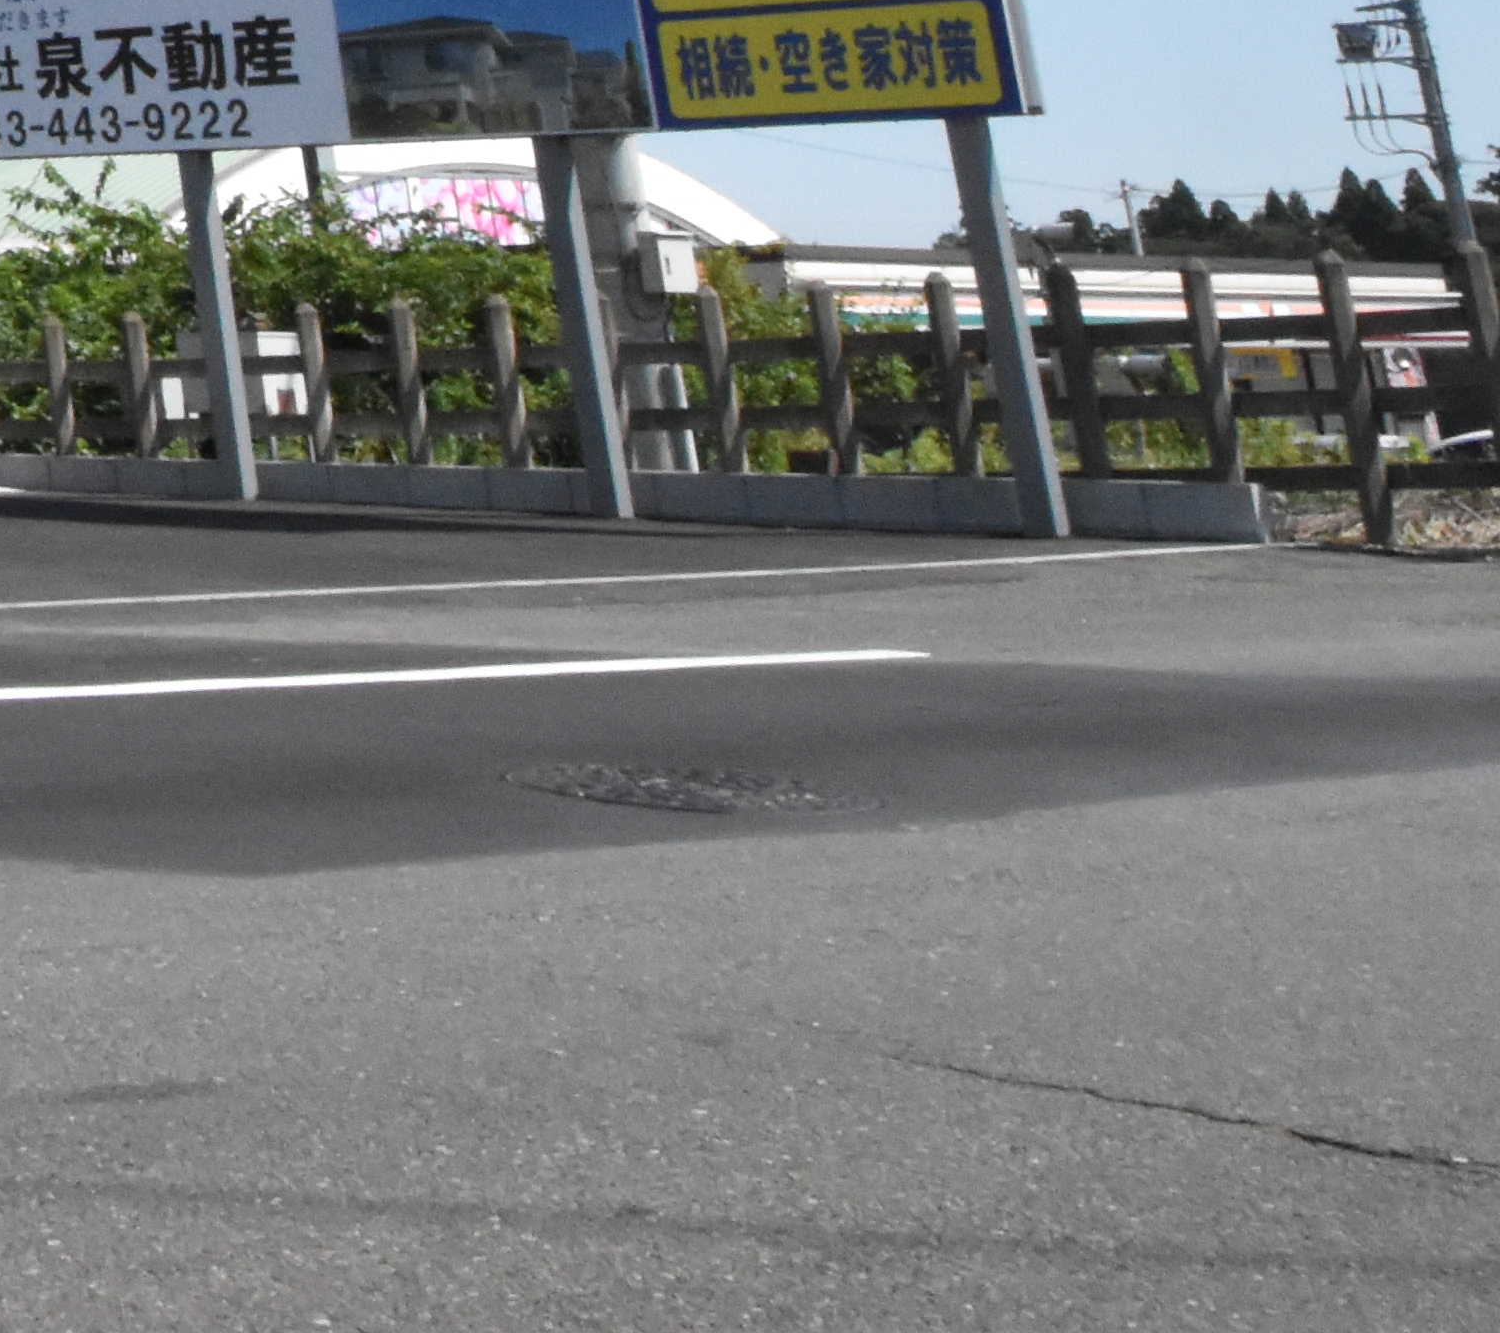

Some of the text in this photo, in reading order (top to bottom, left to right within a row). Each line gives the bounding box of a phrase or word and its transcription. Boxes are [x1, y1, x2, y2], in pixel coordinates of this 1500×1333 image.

[677, 20, 982, 99] 相続・空き家対策
